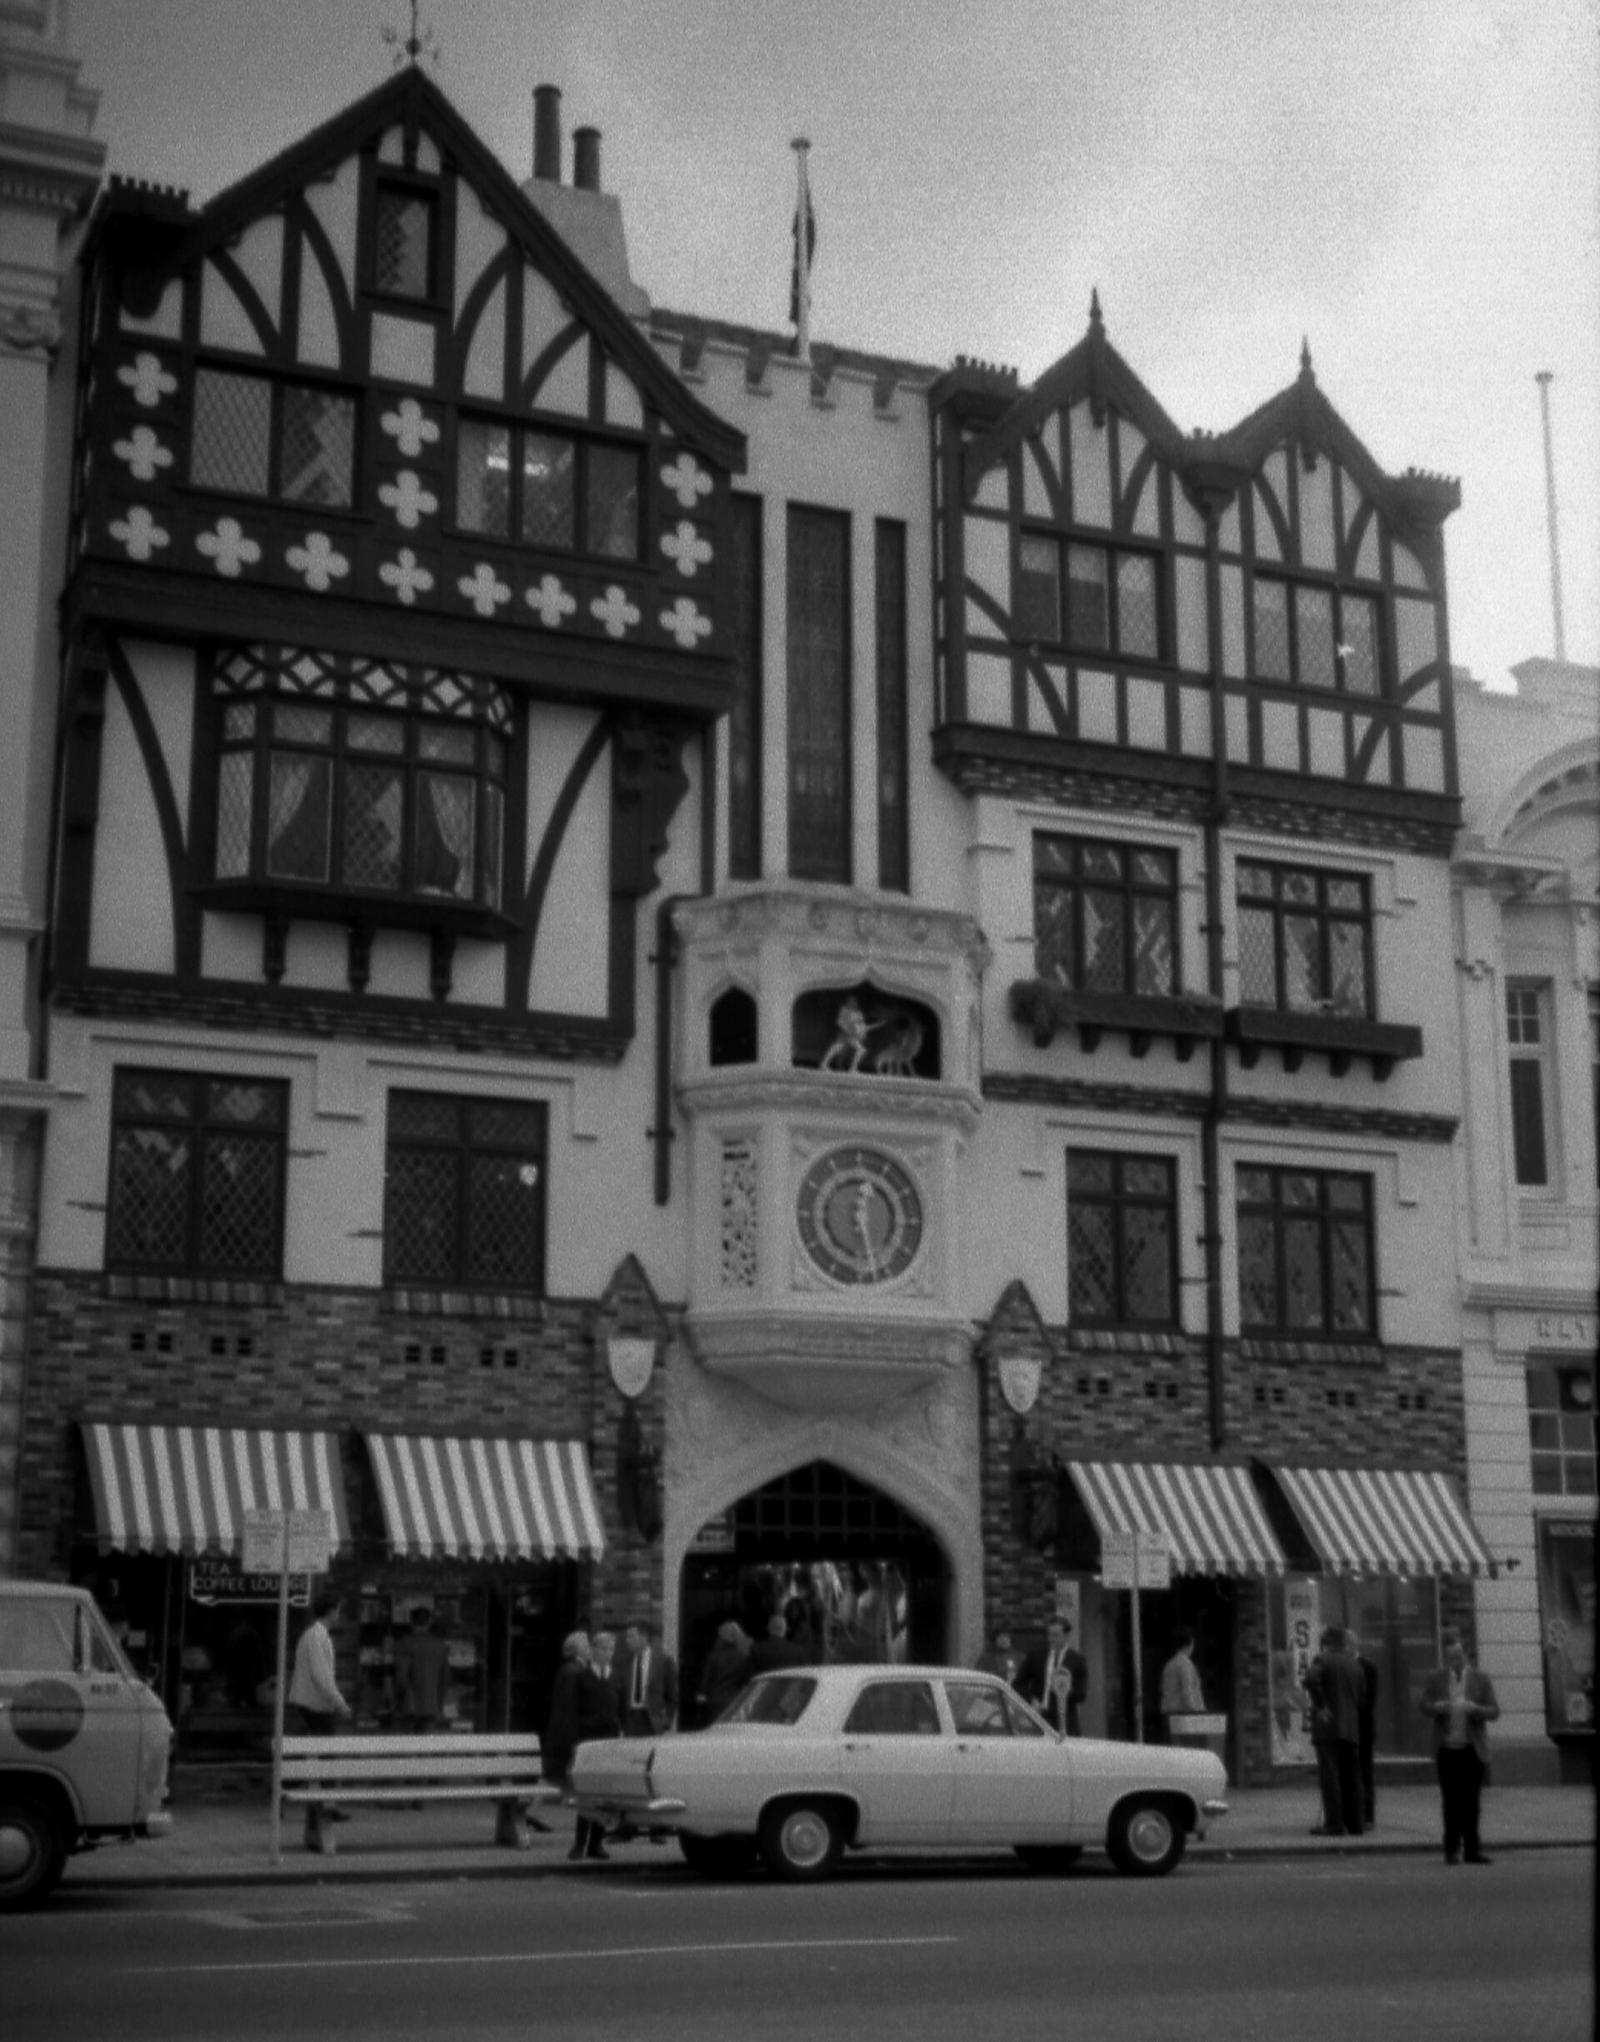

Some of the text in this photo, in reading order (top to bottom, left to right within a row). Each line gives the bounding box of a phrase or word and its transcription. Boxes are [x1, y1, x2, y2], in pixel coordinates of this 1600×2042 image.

[200, 1561, 231, 1576] TEA
[194, 1576, 308, 1591] COFFEE LOUGE
